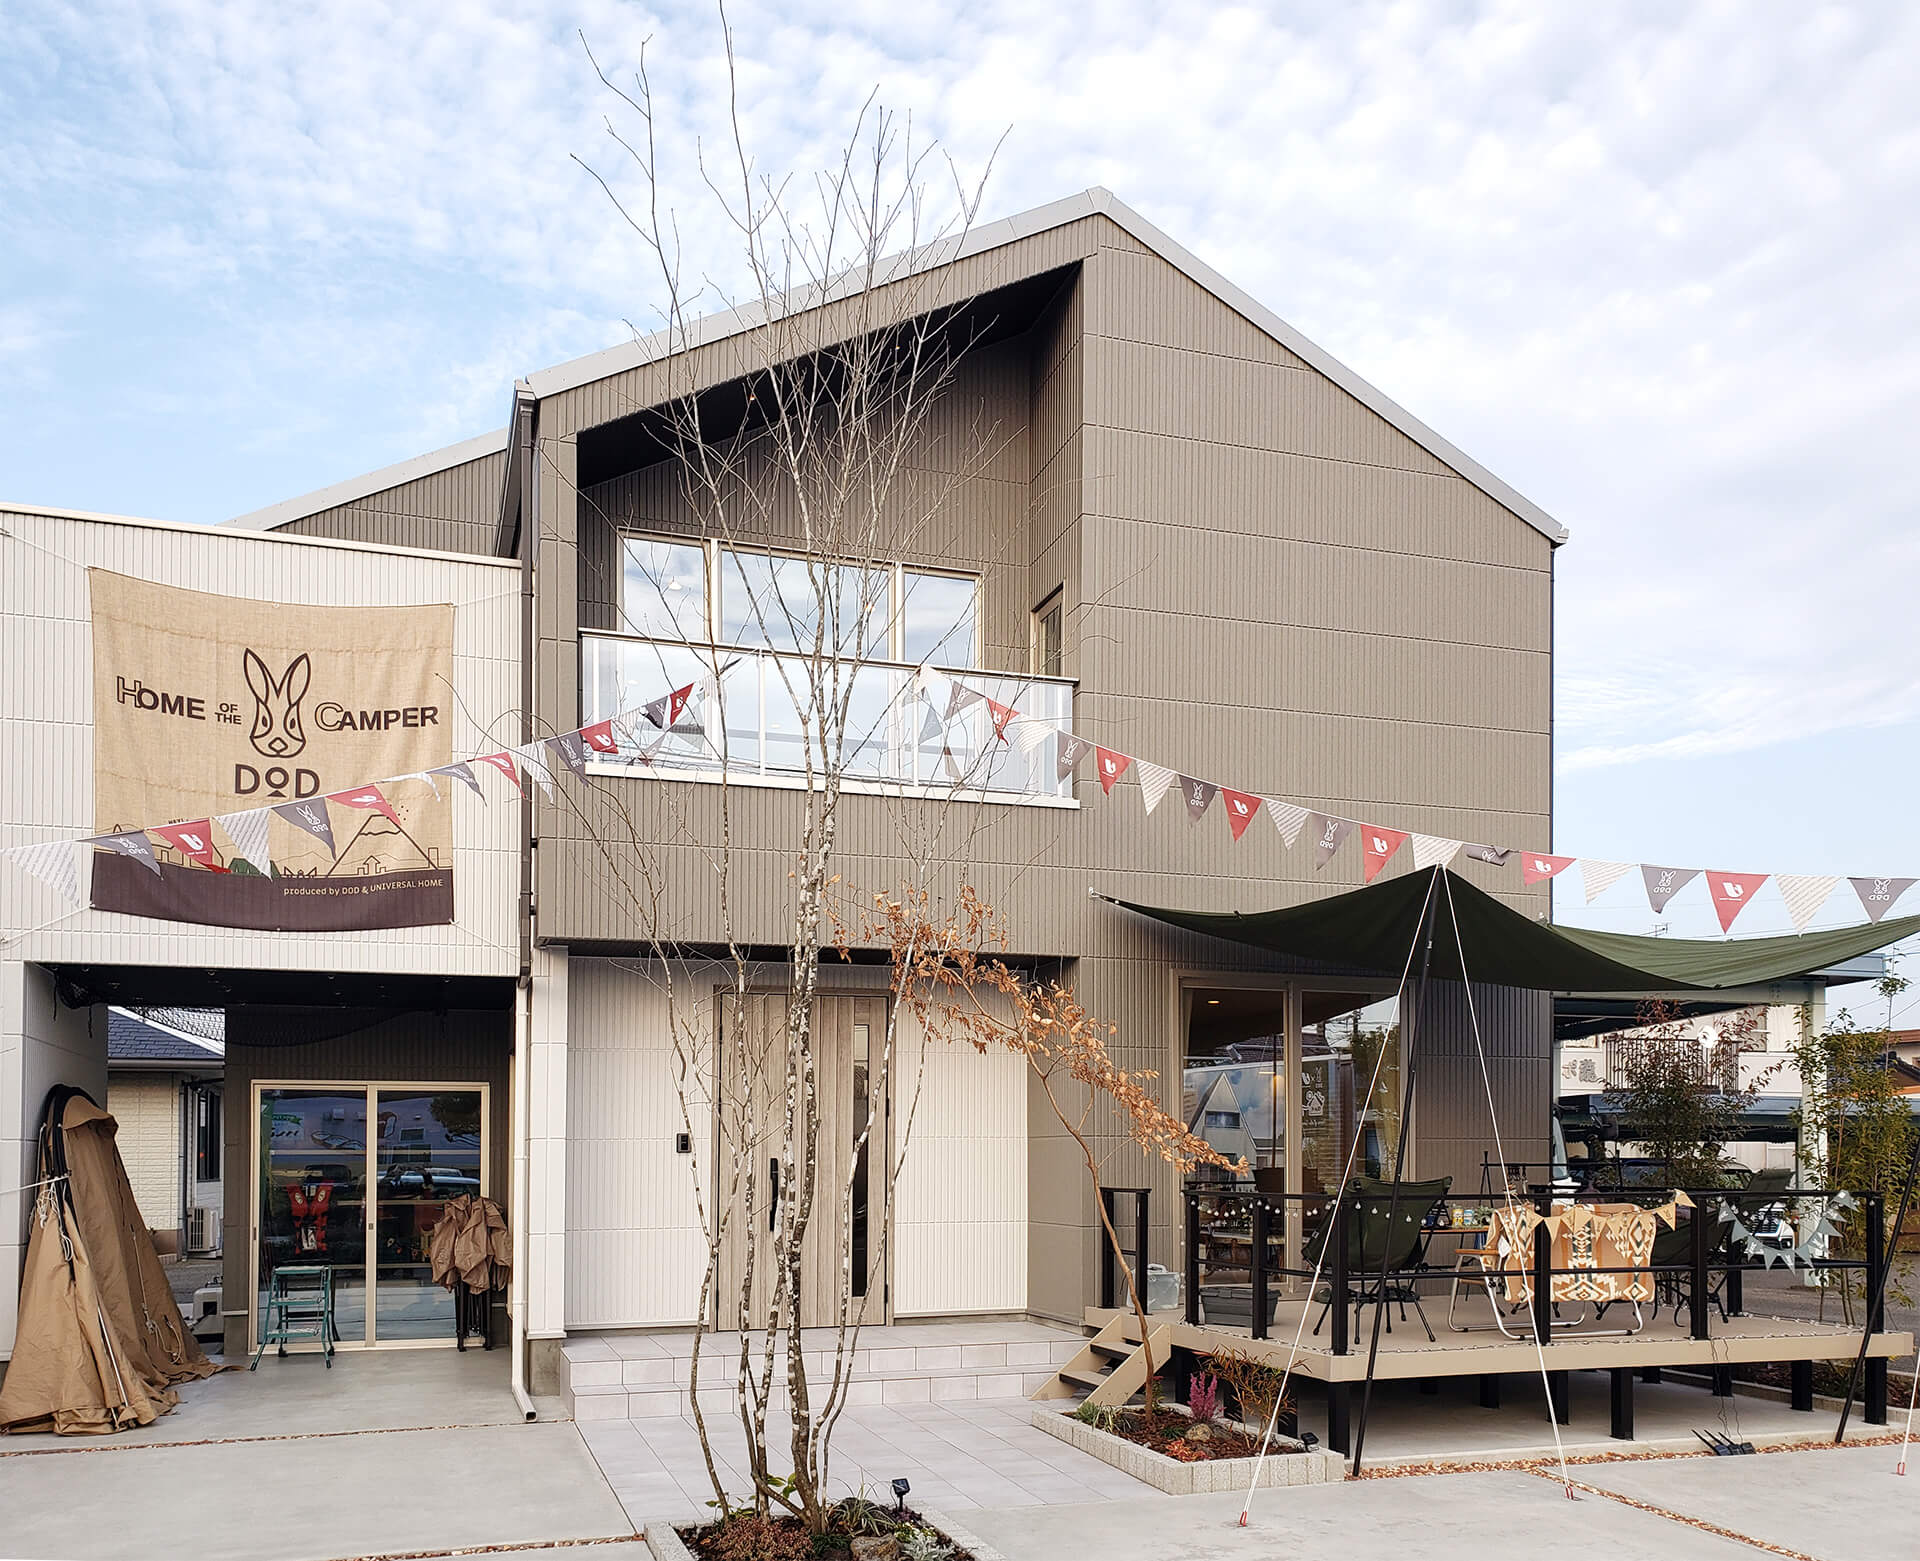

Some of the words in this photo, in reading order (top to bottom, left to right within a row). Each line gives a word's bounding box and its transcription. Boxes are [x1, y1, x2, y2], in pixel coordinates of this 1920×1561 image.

[116, 675, 206, 721] HOME
[219, 702, 239, 714] OF
[214, 711, 242, 725] THE
[314, 702, 439, 732] CAMPER
[234, 763, 320, 799] DOD
[283, 886, 327, 897] produced
[329, 886, 340, 897] by
[341, 886, 360, 895] DOD
[361, 885, 369, 895] &
[370, 880, 417, 892] UNIVERSAL
[417, 878, 443, 888] HOME
